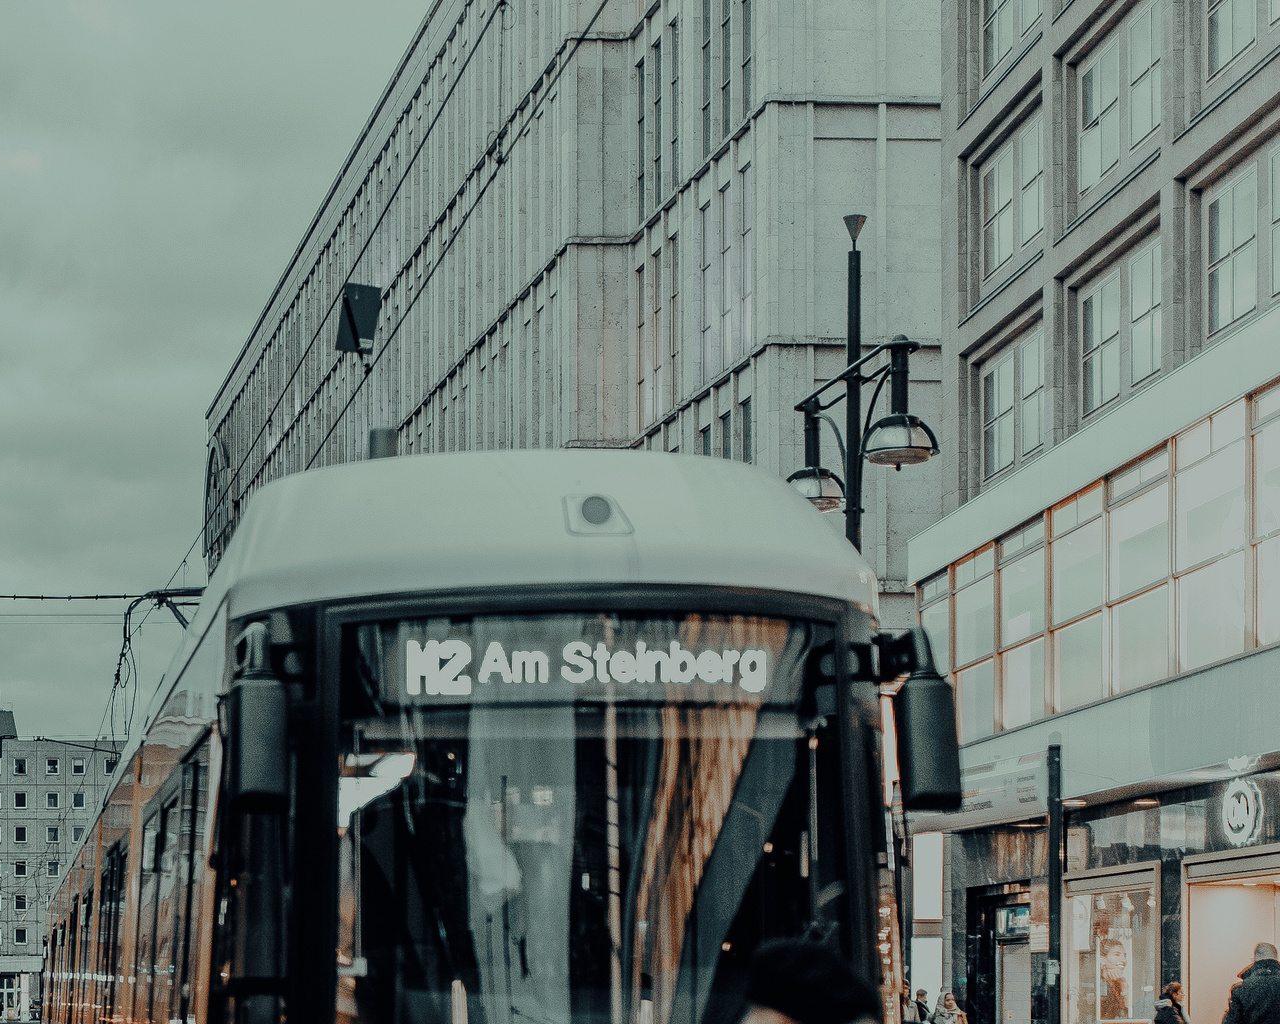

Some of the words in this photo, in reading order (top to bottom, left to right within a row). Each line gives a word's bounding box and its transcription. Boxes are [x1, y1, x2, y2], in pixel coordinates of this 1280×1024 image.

[406, 639, 472, 695] M2
[477, 641, 549, 684] Am
[560, 640, 767, 693] Steinberg
